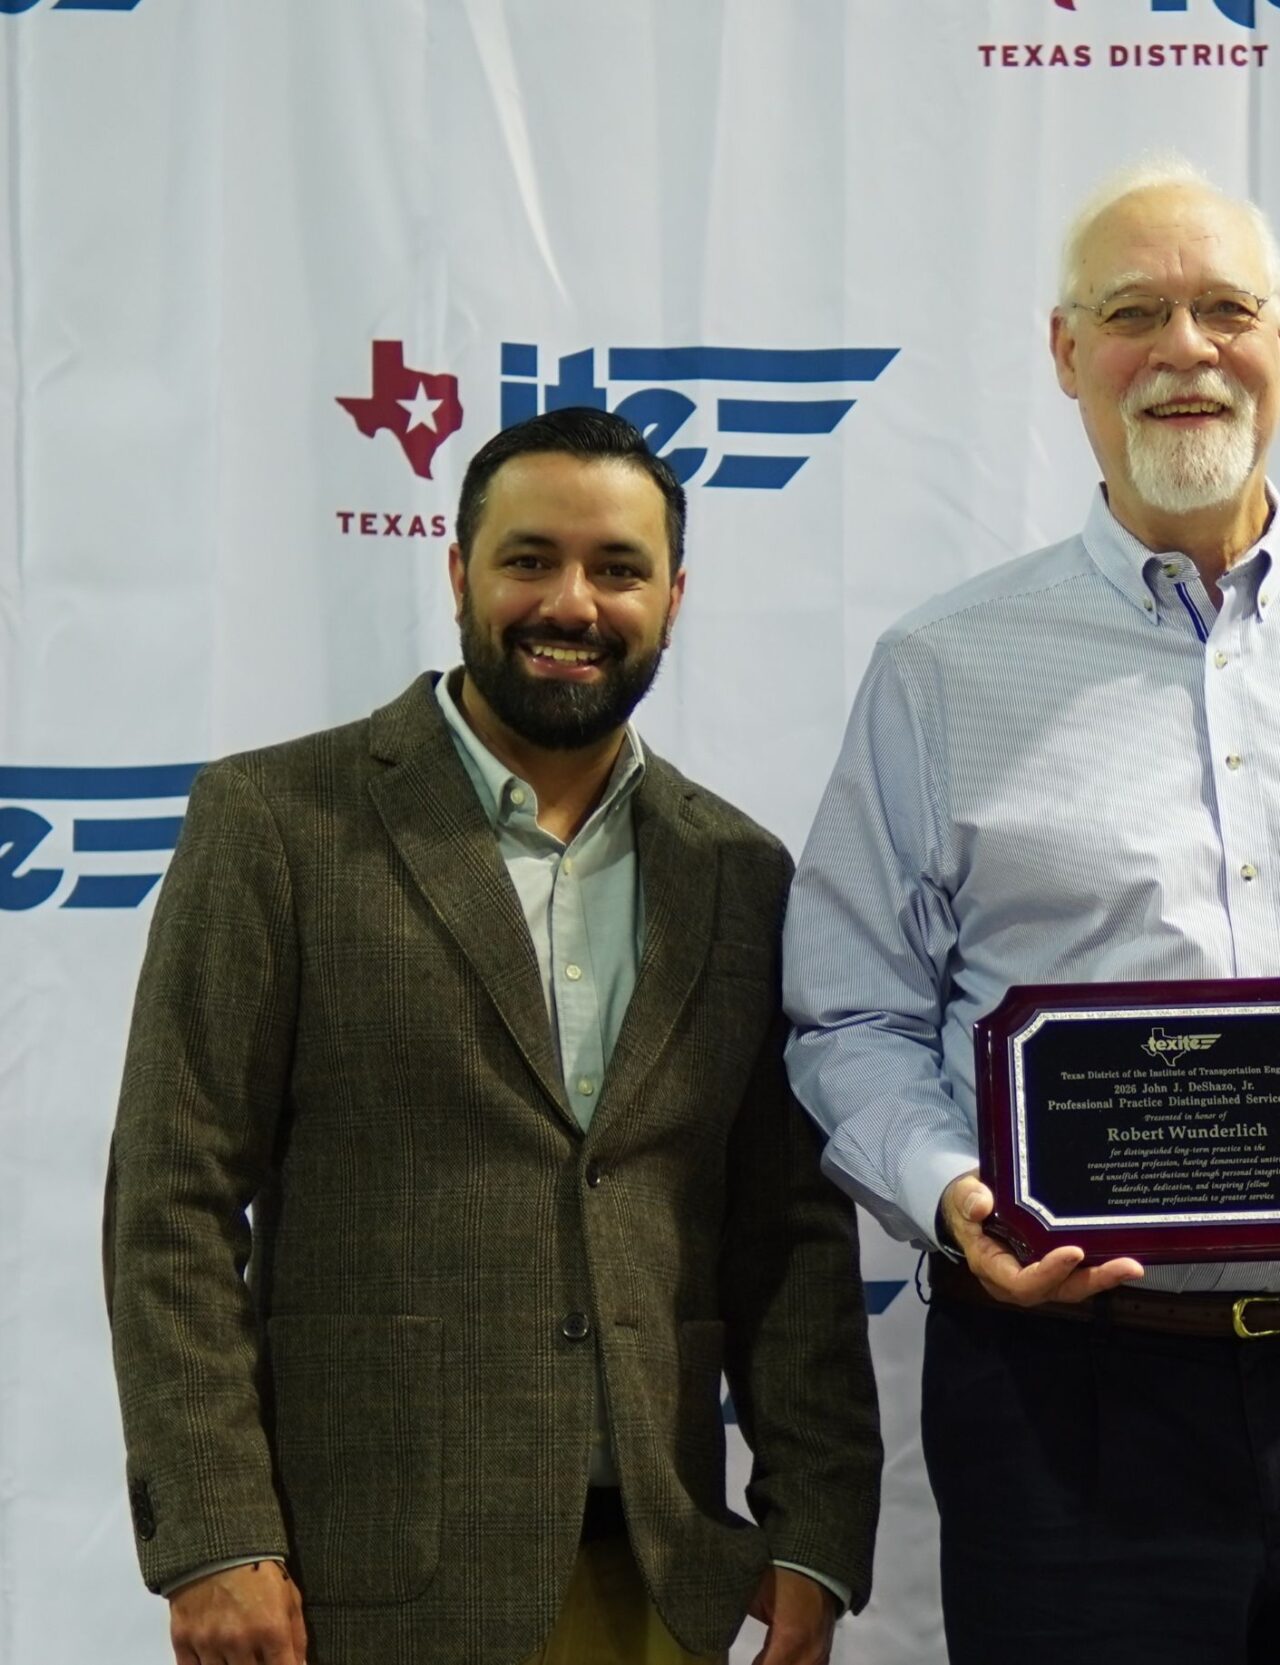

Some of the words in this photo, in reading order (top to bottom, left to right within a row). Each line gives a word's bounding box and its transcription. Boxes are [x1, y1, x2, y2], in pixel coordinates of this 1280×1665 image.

[978, 44, 1092, 67] TEXAS
[1109, 44, 1269, 67] DISTRICT
[336, 511, 446, 537] TEXAS
[1148, 1034, 1201, 1052] texite
[1061, 1071, 1085, 1080] Texas
[1088, 1070, 1119, 1079] District
[1122, 1069, 1132, 1078] of
[1133, 1069, 1147, 1078] the
[1149, 1068, 1186, 1077] Institute
[1188, 1067, 1197, 1076] of
[1199, 1066, 1261, 1076] Transportation
[1114, 1084, 1137, 1094] 2026
[1142, 1083, 1168, 1094] John
[1173, 1082, 1183, 1092] J.
[1188, 1081, 1237, 1092] DeShazo,
[1241, 1080, 1255, 1091] Jr.
[1048, 1098, 1113, 1110] Professional
[1119, 1097, 1163, 1108] Practice
[1168, 1094, 1240, 1107] Distinguished
[1144, 1112, 1183, 1122] Presented
[1184, 1112, 1192, 1120] in
[1194, 1111, 1216, 1120] honor
[1218, 1110, 1228, 1121] of
[1107, 1126, 1164, 1141] Robert
[1168, 1123, 1268, 1139] Wunderlich
[1109, 1148, 1121, 1159] for
[1124, 1146, 1172, 1157] distinguished
[1174, 1145, 1209, 1156] long-term
[1212, 1144, 1241, 1155] practice
[1244, 1144, 1251, 1152] in
[1254, 1143, 1265, 1151] the
[1088, 1160, 1139, 1171] transportation
[1141, 1158, 1180, 1169] profession,
[1183, 1157, 1208, 1167] having
[1210, 1155, 1259, 1165] demonstrated
[1090, 1173, 1104, 1181] and
[1106, 1171, 1139, 1182] unselfish
[1141, 1170, 1189, 1179] contributions
[1192, 1169, 1220, 1180] through
[1222, 1168, 1252, 1179] personal
[1112, 1184, 1151, 1194] leadership,
[1153, 1183, 1193, 1192] dedication,
[1196, 1182, 1211, 1190] and
[1212, 1181, 1244, 1191] inspiring
[1246, 1179, 1270, 1191] fellow
[1108, 1197, 1160, 1207] transportation
[1162, 1195, 1208, 1205] professionals
[1211, 1194, 1218, 1202] to
[1219, 1194, 1247, 1204] greater
[1249, 1192, 1275, 1201] service
